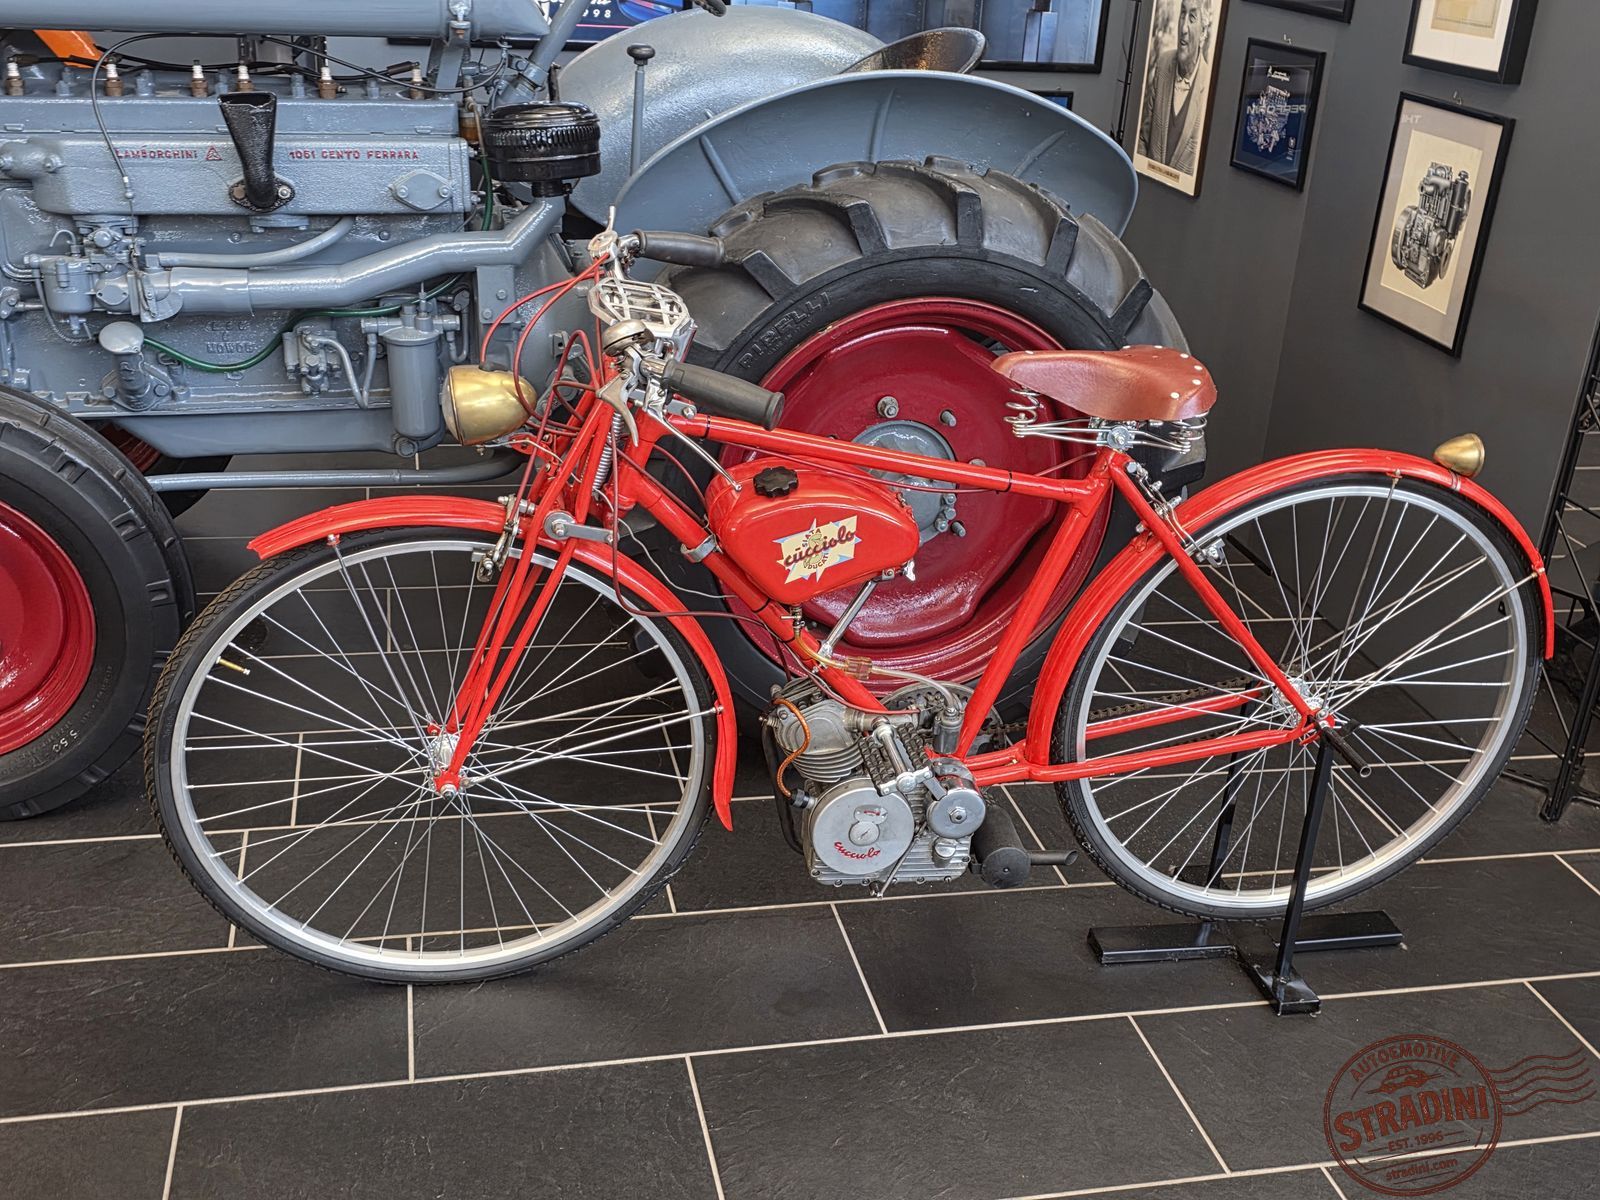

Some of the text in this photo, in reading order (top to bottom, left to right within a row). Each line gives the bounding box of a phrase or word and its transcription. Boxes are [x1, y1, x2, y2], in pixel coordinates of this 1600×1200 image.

[114, 148, 198, 159] LAMBORGHINI
[321, 150, 360, 160] CENTO
[366, 150, 419, 160] FERRARA
[739, 291, 831, 369] PIRELLI
[801, 528, 822, 548] SIATA
